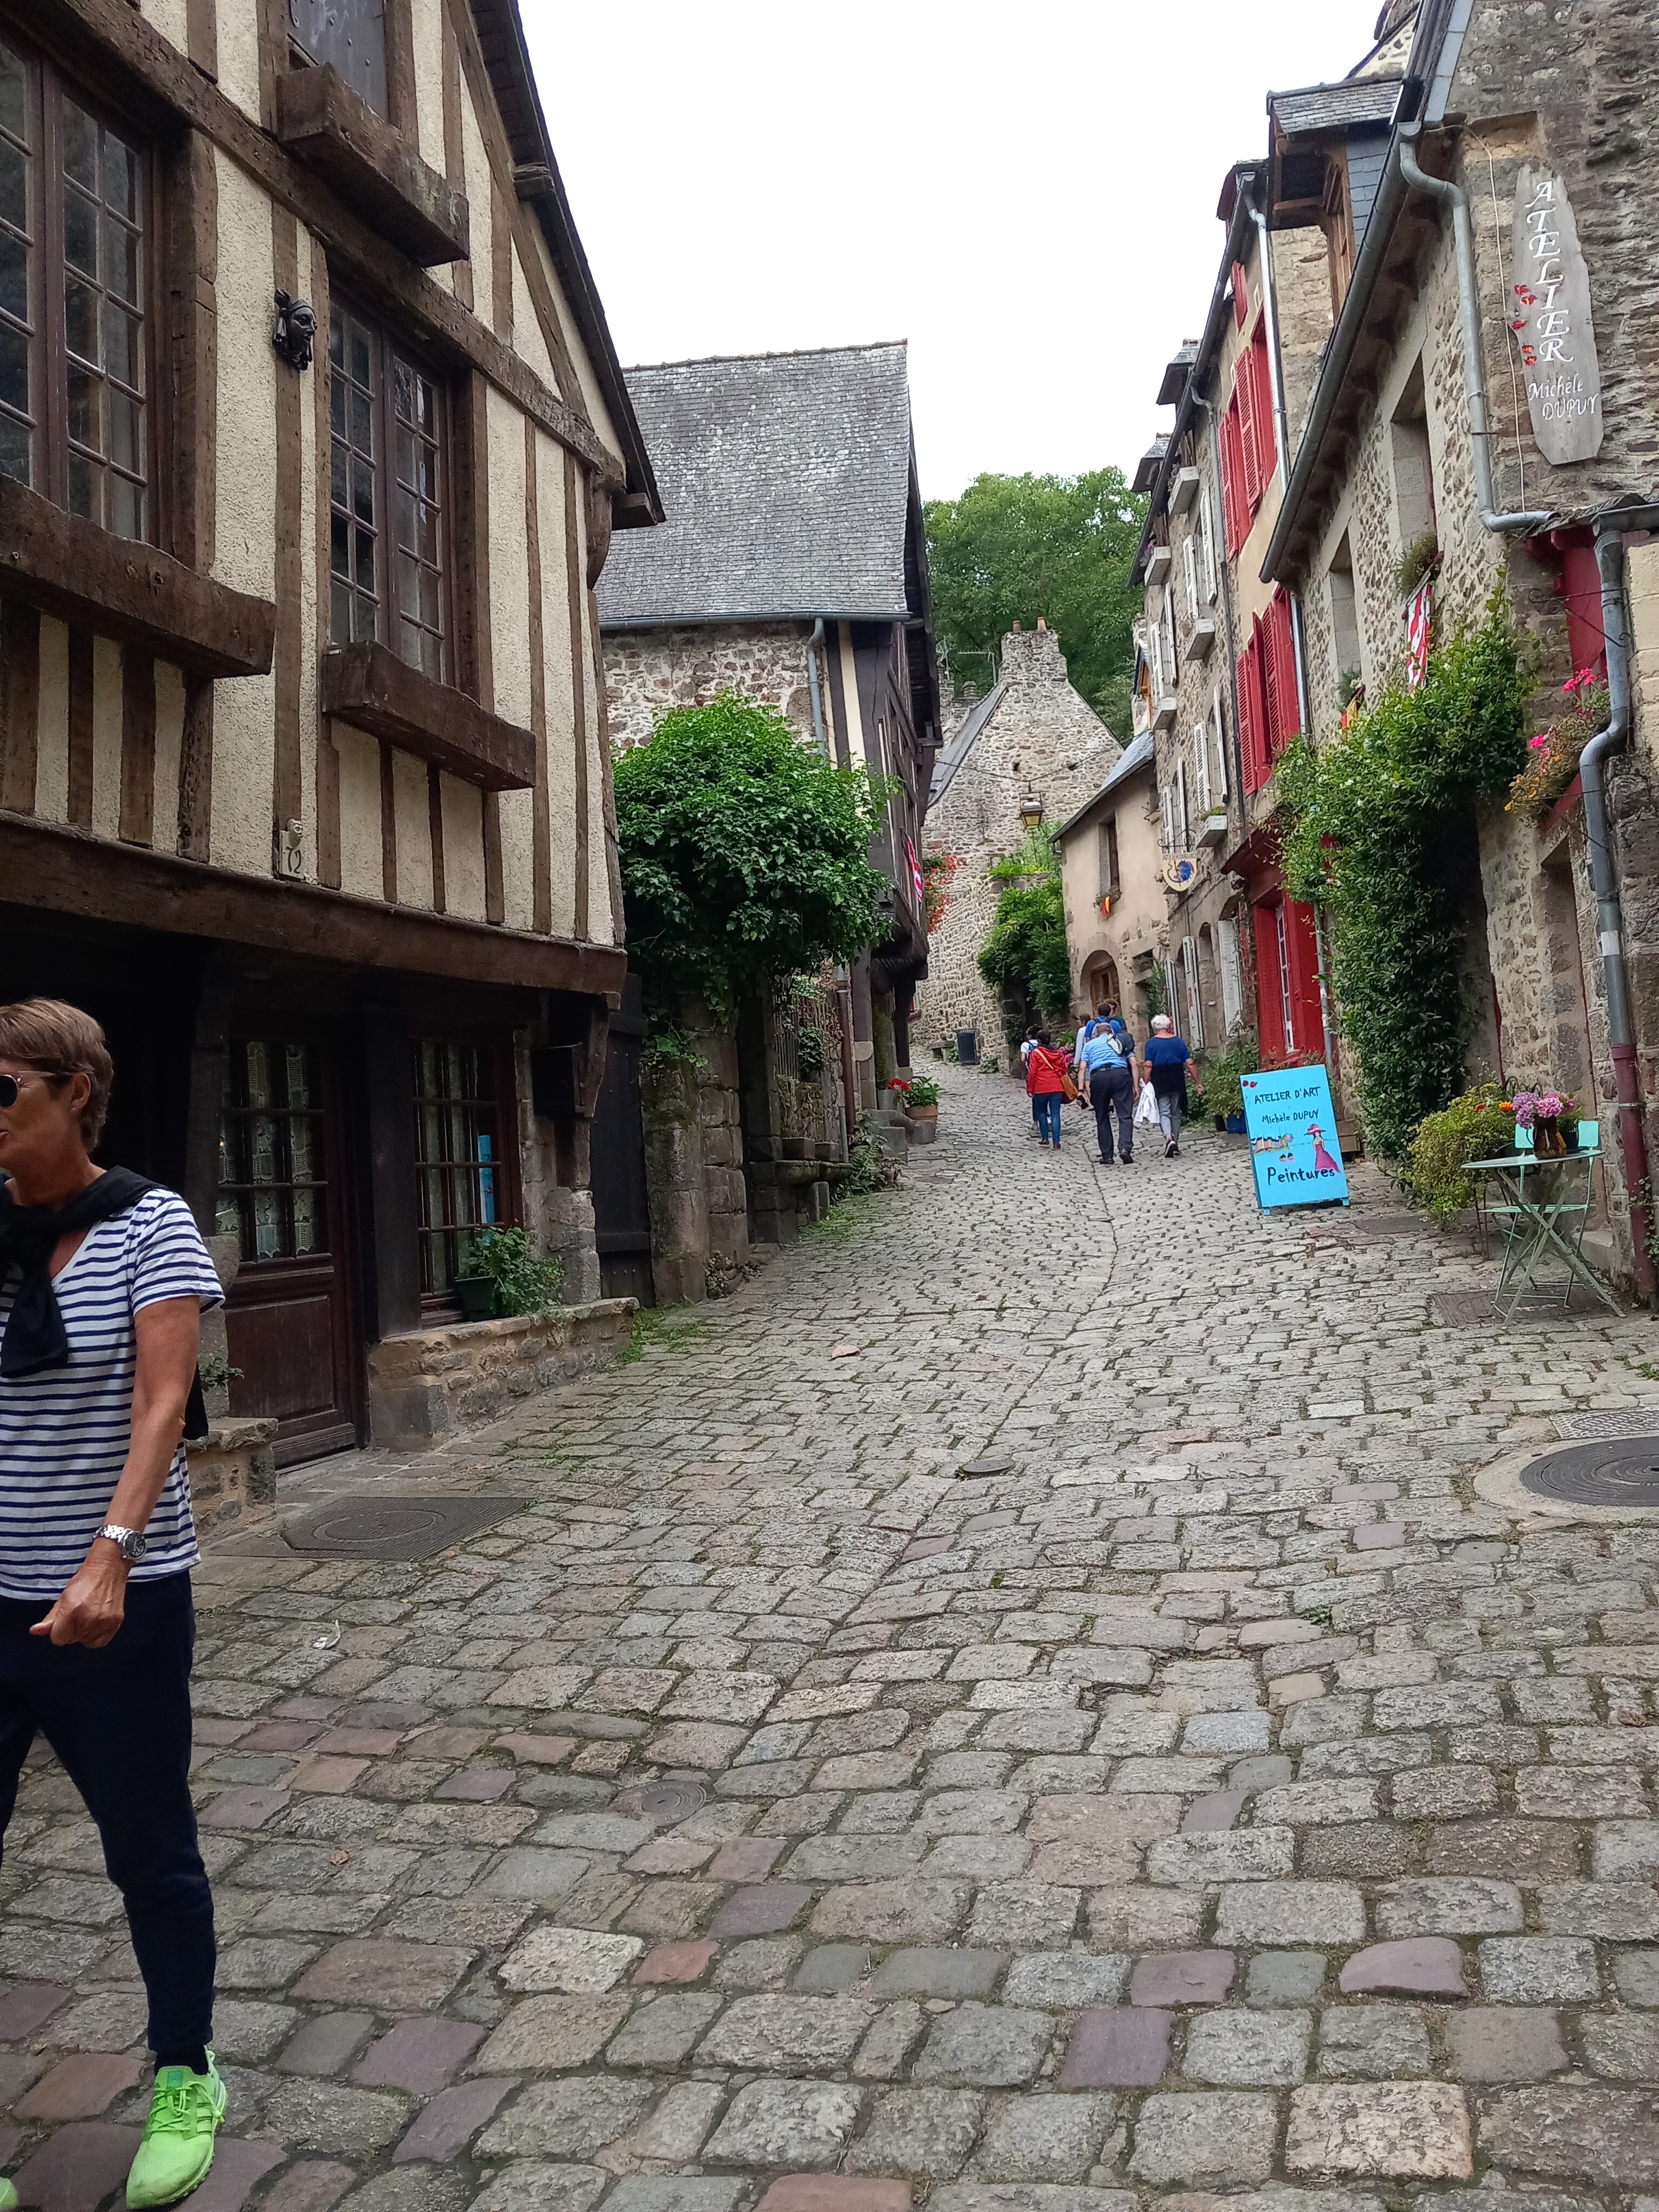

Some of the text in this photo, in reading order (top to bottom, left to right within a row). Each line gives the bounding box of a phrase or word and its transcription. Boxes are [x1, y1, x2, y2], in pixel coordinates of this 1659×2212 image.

[1524, 180, 1574, 363] ATELIER
[1528, 372, 1584, 401] Michèle
[1541, 393, 1599, 421] DUPUY
[286, 846, 302, 874] 72
[1255, 1086, 1321, 1104] ATELIER D'ART
[1293, 1109, 1319, 1121] DUPUY
[1267, 1166, 1335, 1186] Peintures
